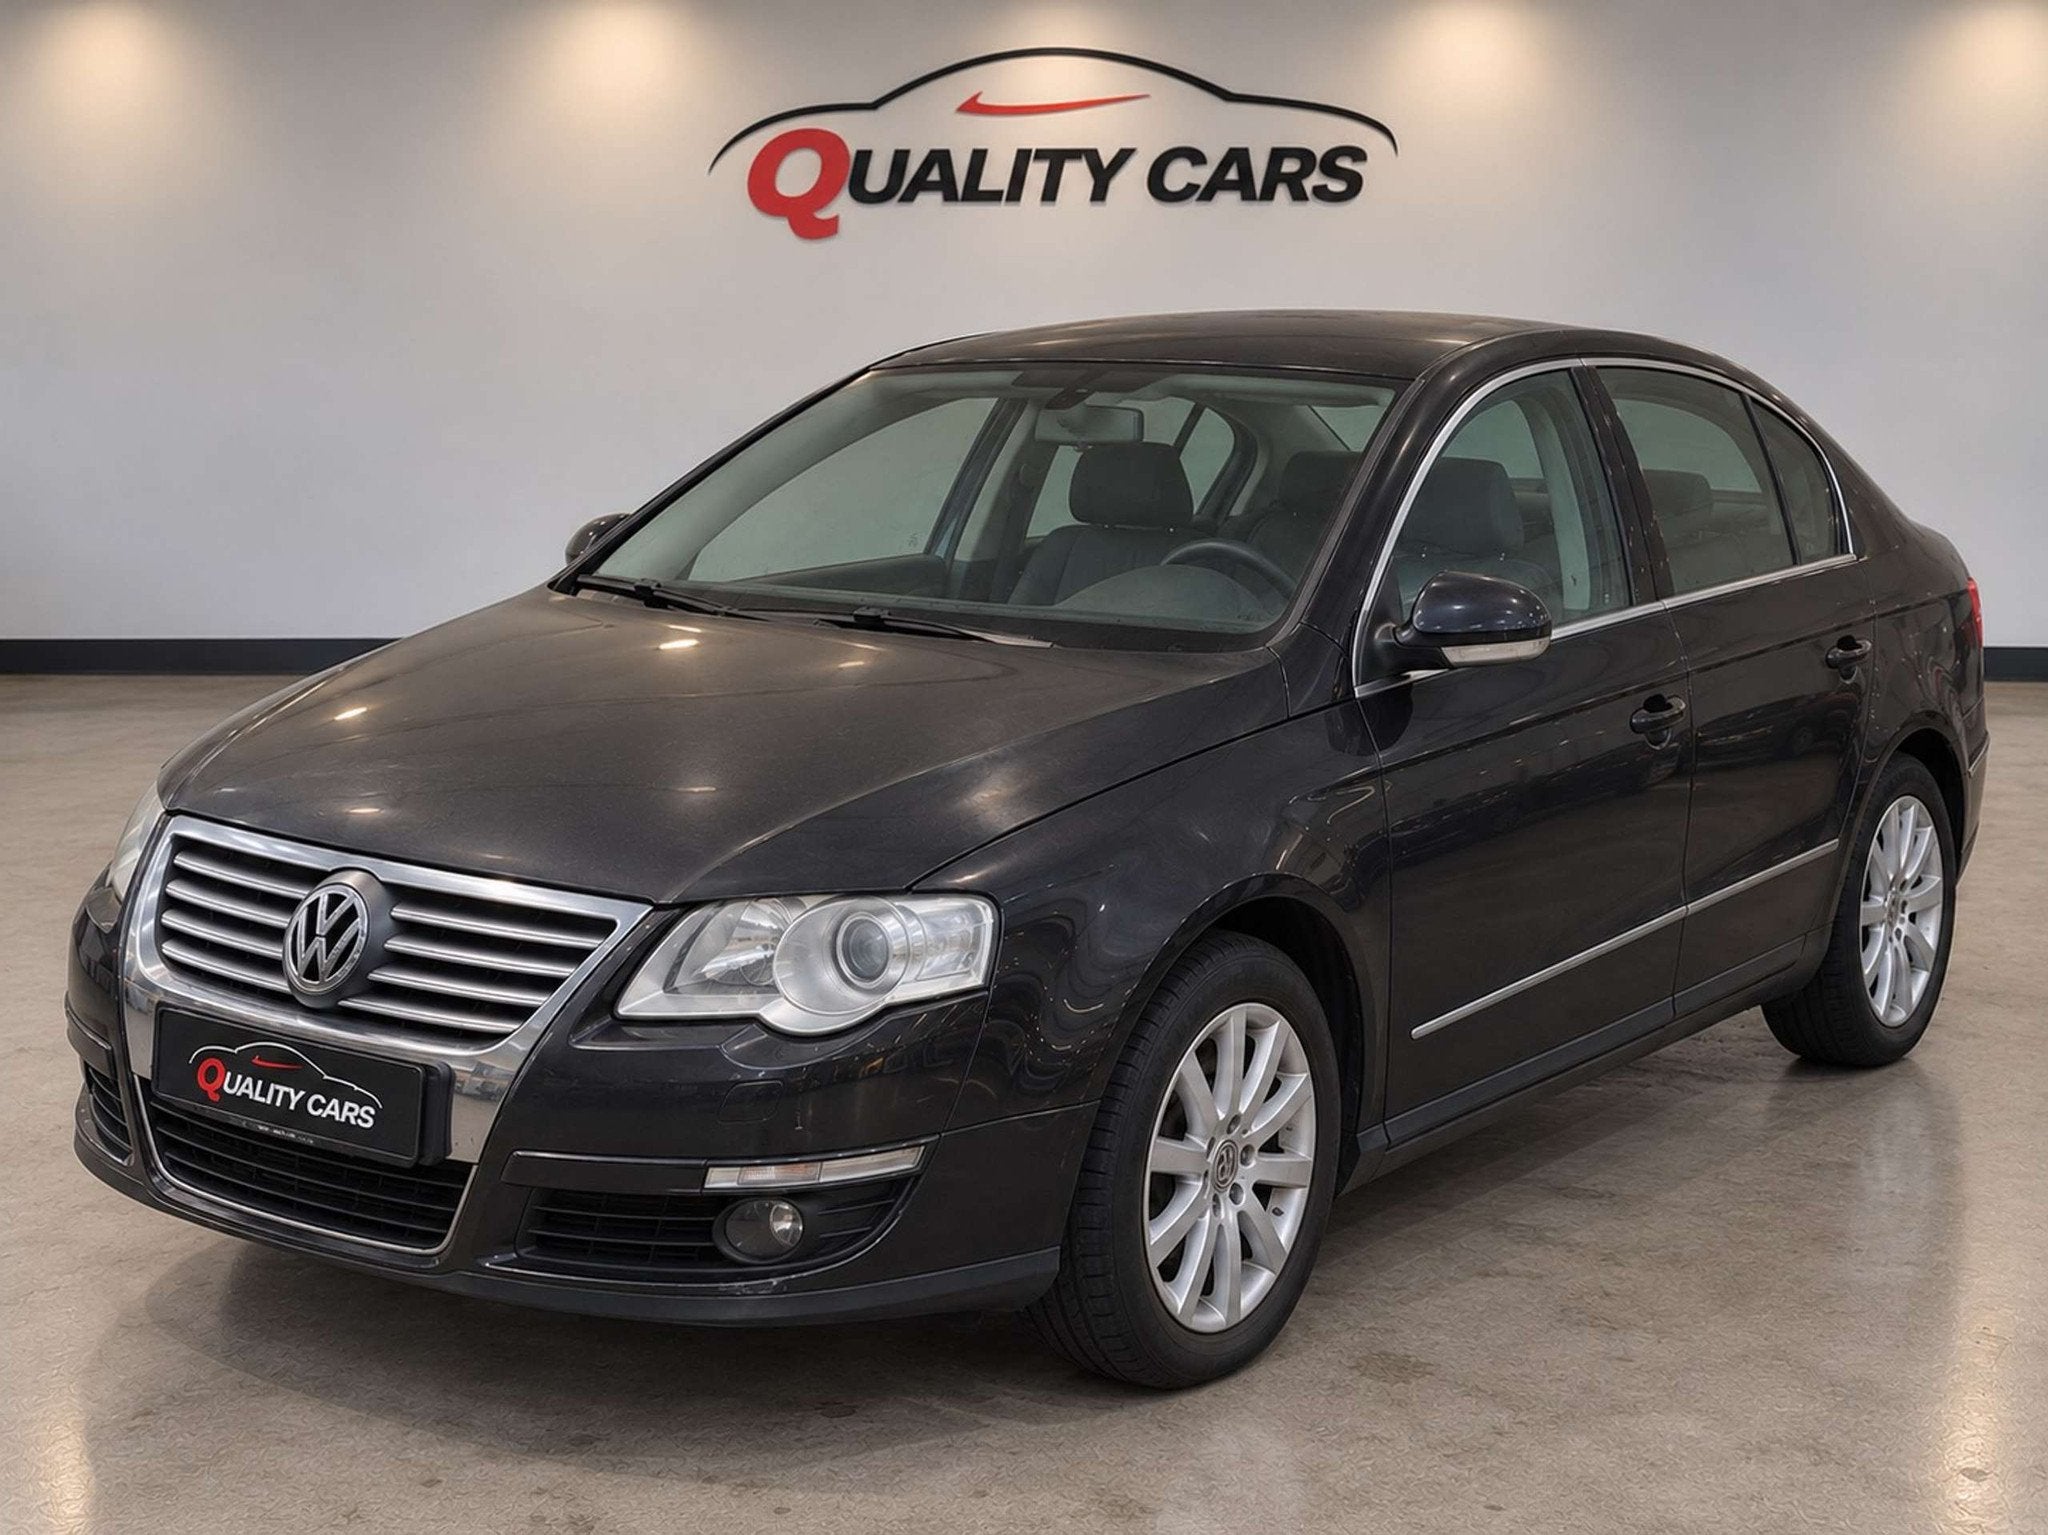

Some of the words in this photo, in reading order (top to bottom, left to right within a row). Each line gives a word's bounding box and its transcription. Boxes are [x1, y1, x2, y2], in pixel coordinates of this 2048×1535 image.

[746, 127, 1137, 241] QUALITY
[1146, 145, 1368, 204] CARS
[292, 888, 364, 986] VW
[196, 1057, 305, 1111] QUALITY
[306, 1093, 376, 1130] CARS
